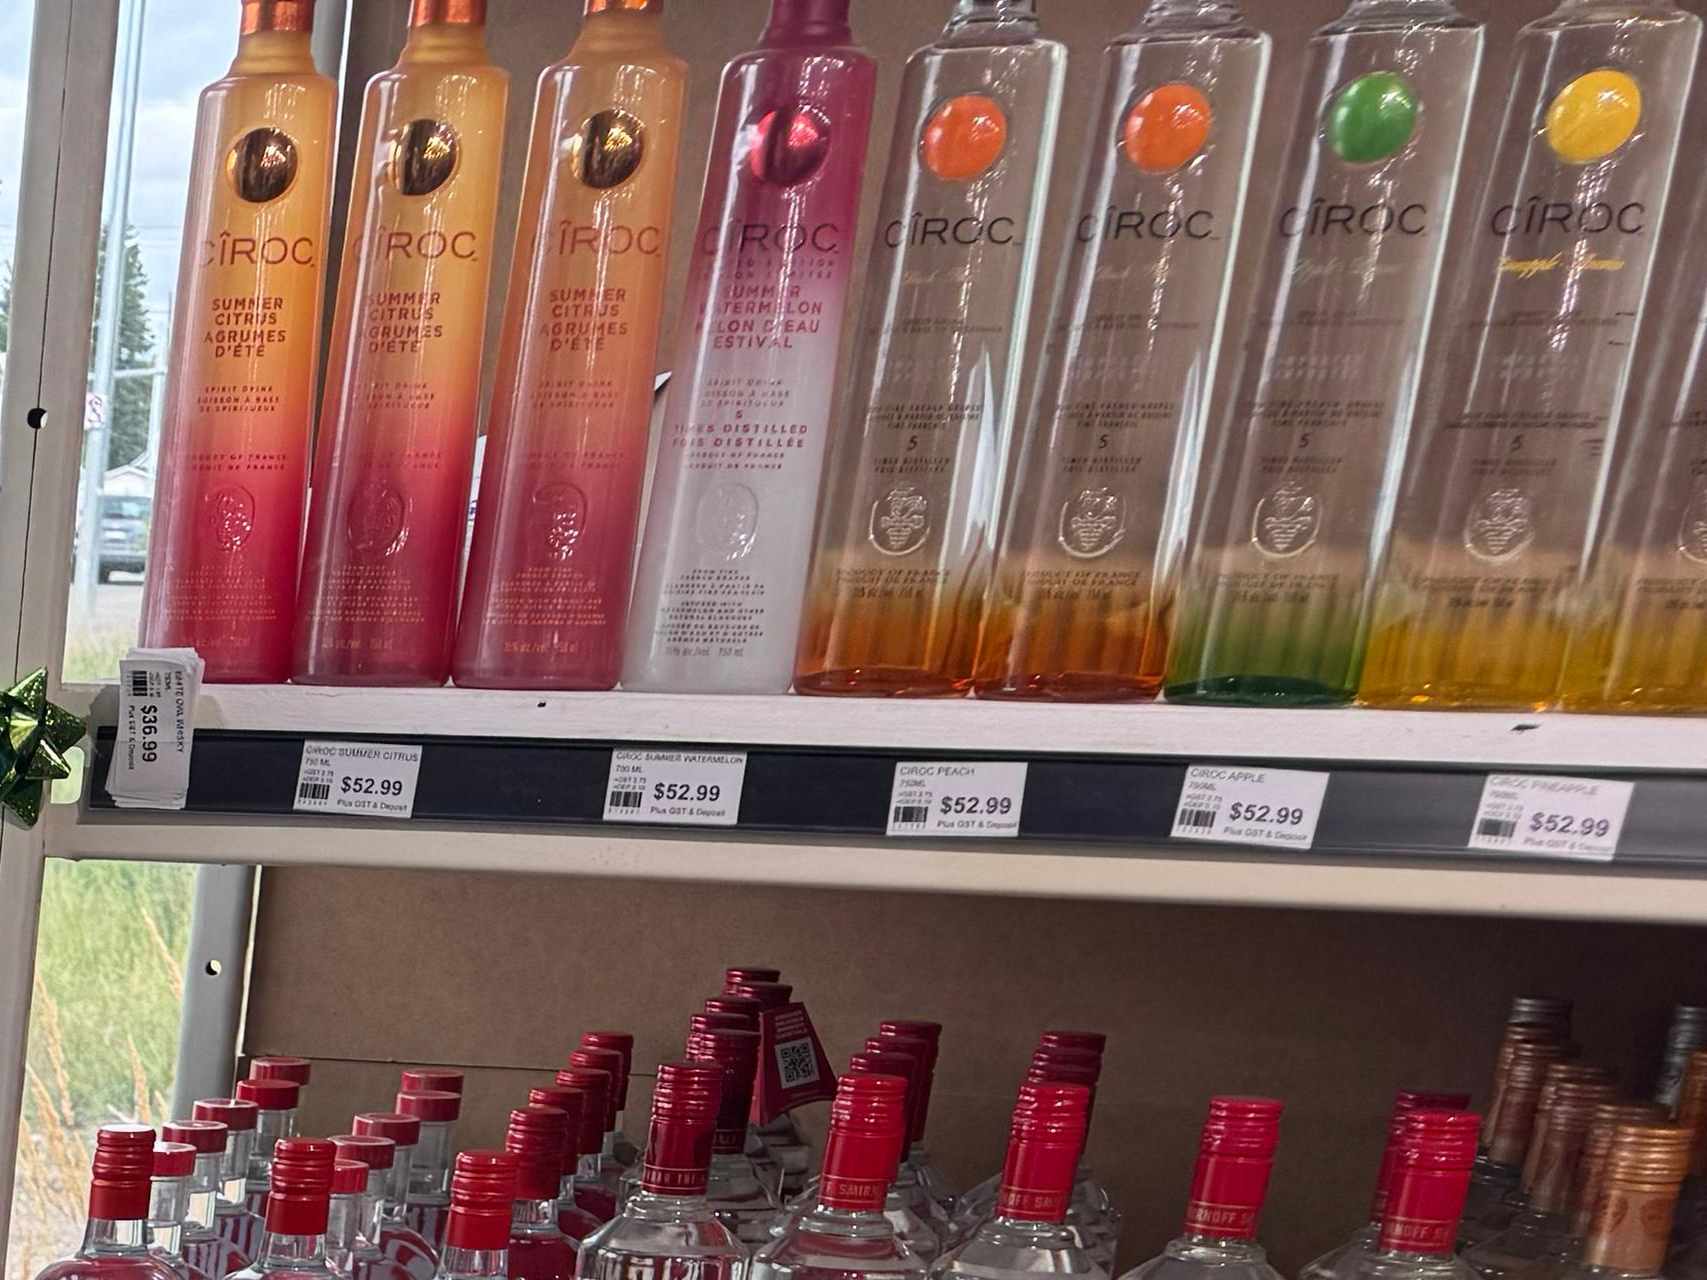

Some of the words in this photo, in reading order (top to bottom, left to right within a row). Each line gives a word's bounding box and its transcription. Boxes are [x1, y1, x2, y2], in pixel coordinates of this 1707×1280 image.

[211, 295, 284, 314] SUMMER
[215, 311, 278, 328] CITRUS
[203, 328, 286, 346] AGRUMES
[714, 336, 793, 349] ESTIVAL
[214, 340, 266, 359] D'ÉTÉ
[723, 424, 807, 434] DISTILLED
[141, 705, 158, 762] $36.99
[383, 752, 418, 762] CITRUS
[937, 767, 975, 776] PEACH
[1228, 771, 1265, 783] APPLE
[341, 777, 402, 796] $52.99
[940, 797, 1012, 815] $52.99
[1229, 802, 1304, 825] $52.99
[1530, 812, 1610, 838] $52.99
